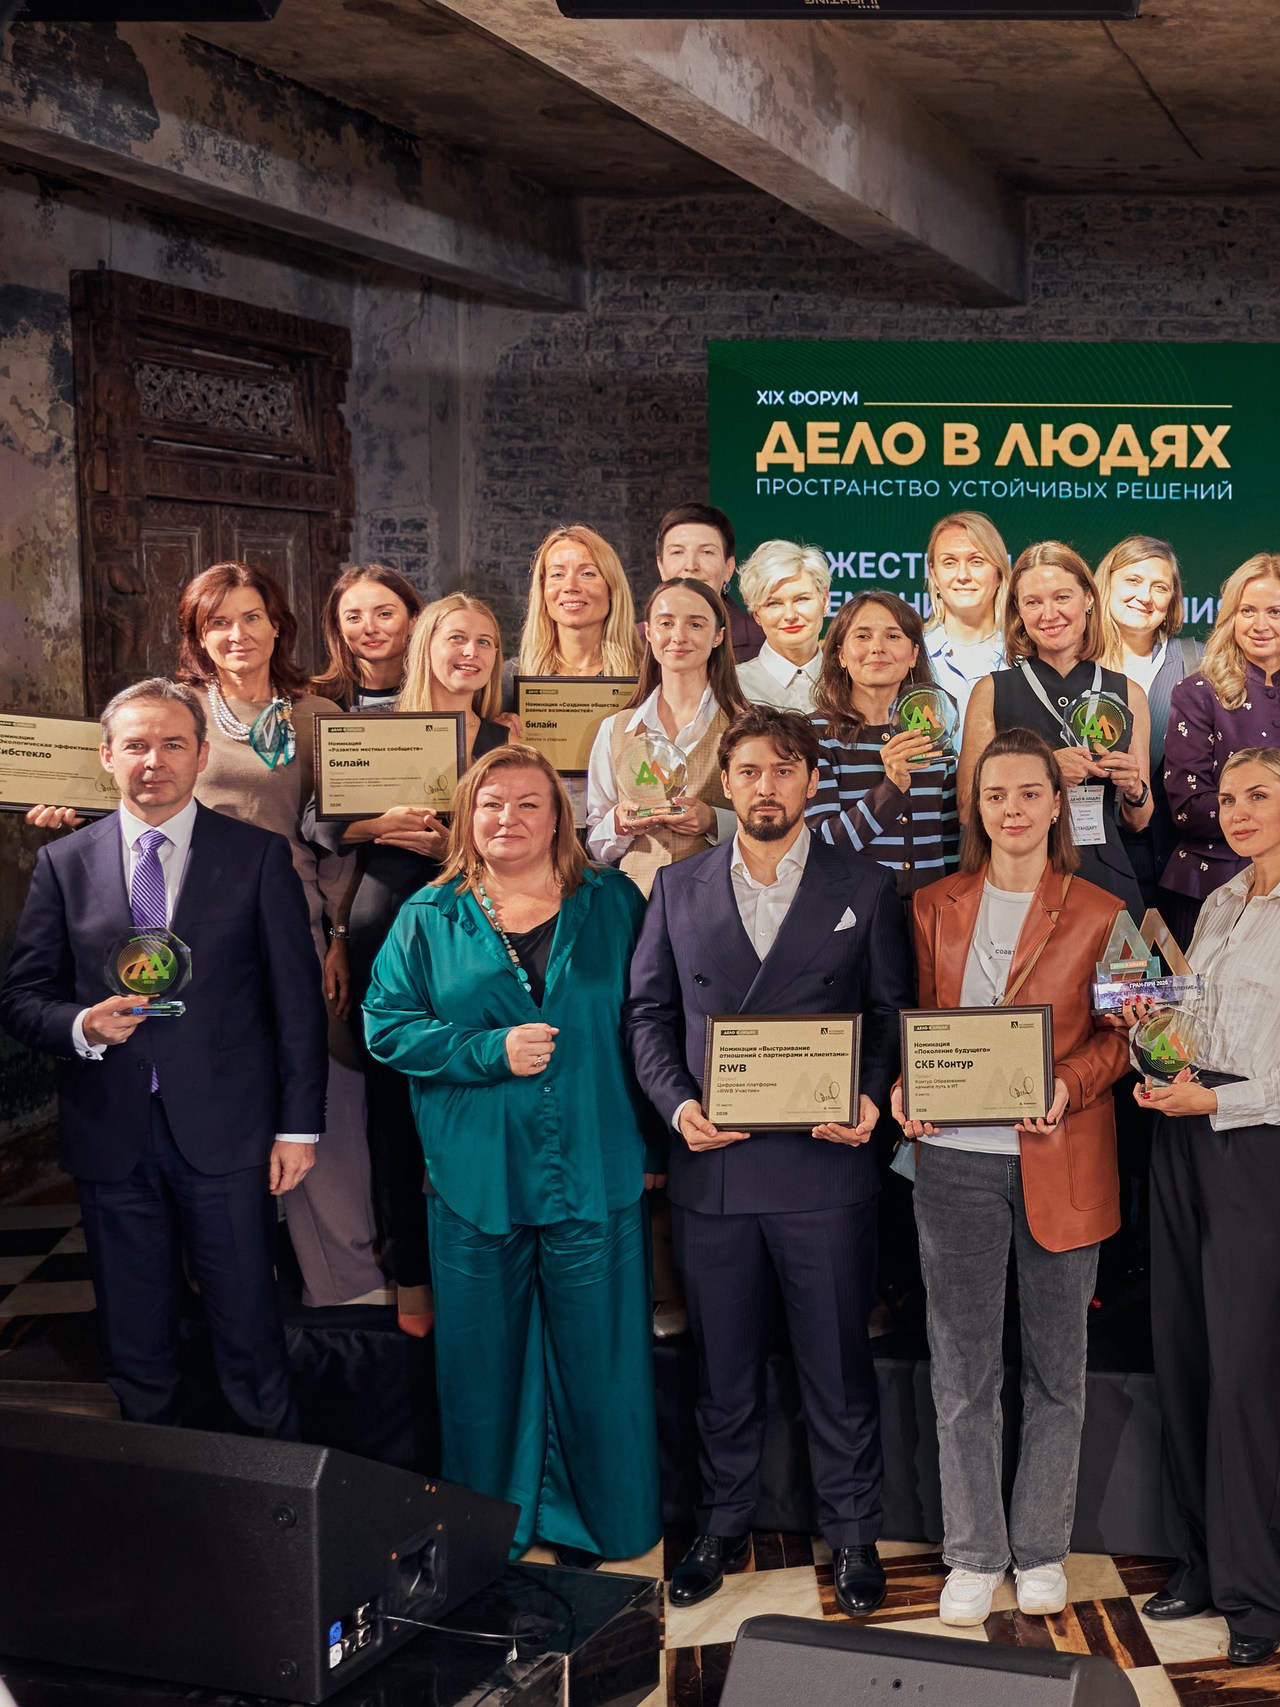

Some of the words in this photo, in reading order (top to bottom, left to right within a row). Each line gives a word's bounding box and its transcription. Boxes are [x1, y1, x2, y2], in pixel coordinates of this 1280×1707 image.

[757, 390, 785, 405] XIX
[789, 390, 858, 406] ФОРУМ
[756, 421, 926, 473] ДЕЛО
[943, 422, 981, 466] В
[994, 422, 1232, 476] ЛЮДЯХ
[756, 478, 940, 497] ПРОСТРАНСТВО
[949, 478, 1108, 499] УСТОЙЧИВЫХ
[1117, 480, 1233, 500] РЕШЕНИЙ
[526, 720, 557, 729] билайн
[0, 747, 52, 759] ибстекло
[329, 758, 370, 767] билайн
[954, 1047, 990, 1055] будущего»
[719, 1063, 747, 1073] RWB
[915, 1060, 935, 1069] СКБ
[937, 1060, 974, 1070] Контур
